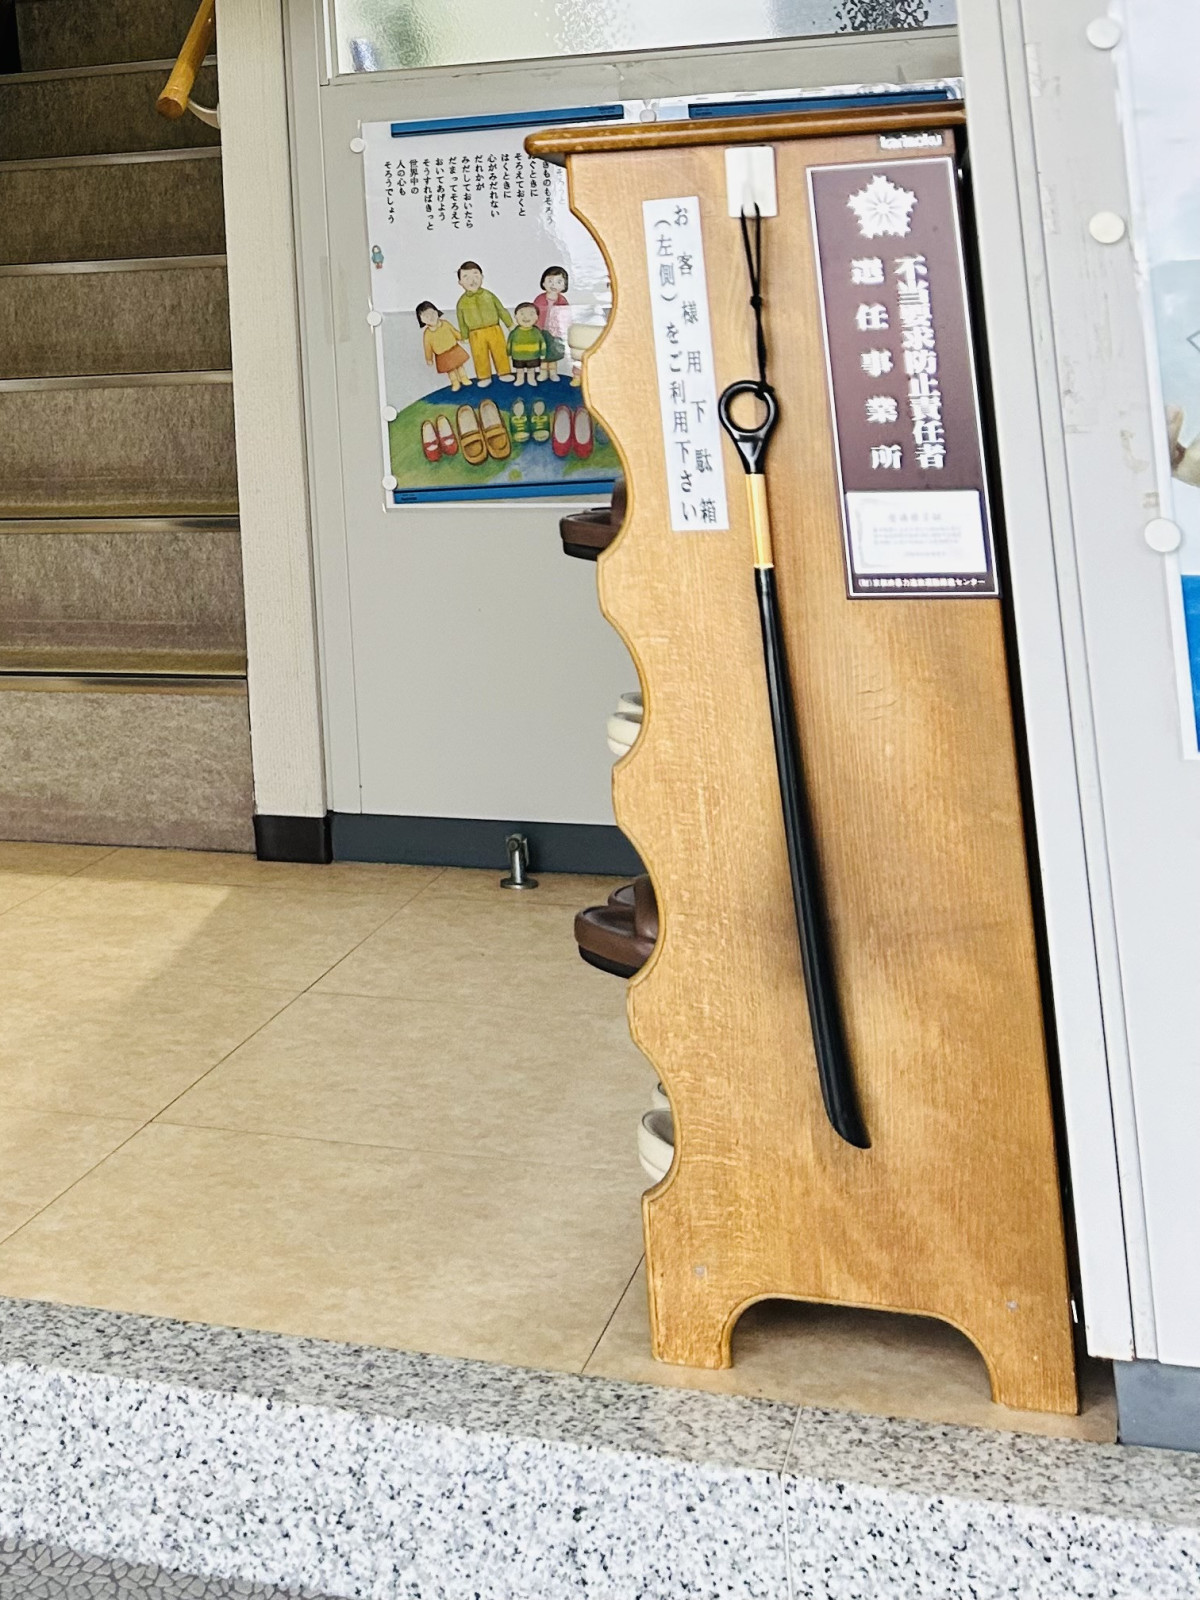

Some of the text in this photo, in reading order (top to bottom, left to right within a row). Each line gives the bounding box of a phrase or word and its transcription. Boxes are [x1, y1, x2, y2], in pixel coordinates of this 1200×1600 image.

[384, 161, 395, 225] そろうでしょう
[396, 159, 407, 197] 人の心も
[409, 159, 420, 195] 世界中の
[422, 158, 434, 231] そうすればきっと
[435, 157, 446, 222] おいてあげよう
[448, 156, 461, 230] だまってそろえて
[461, 156, 474, 229] みだしておいたら
[474, 154, 485, 192] だれかが
[487, 153, 500, 218] 心がみだれない
[501, 153, 512, 199] はくときに
[514, 153, 526, 217] そろえておくと
[542, 161, 553, 225] きものもそろう
[674, 204, 717, 524] お客様用下駄箱
[850, 256, 902, 470] 選任事業所
[893, 253, 947, 469] 不当要求防止責任者
